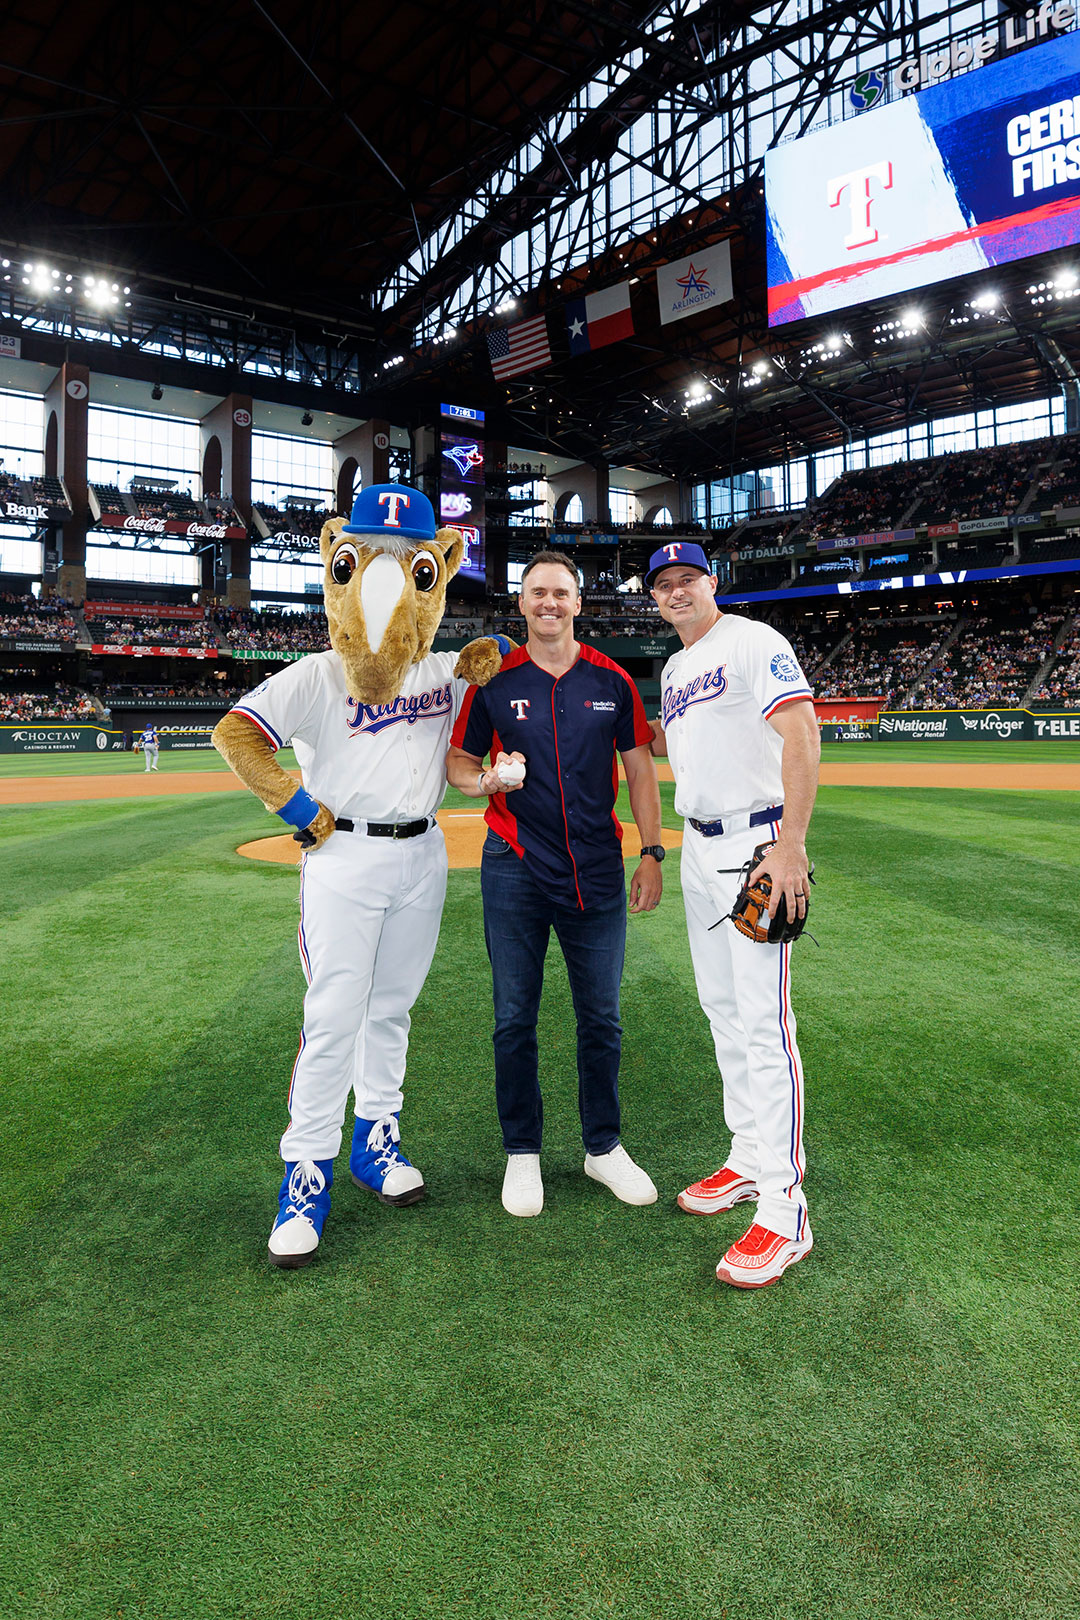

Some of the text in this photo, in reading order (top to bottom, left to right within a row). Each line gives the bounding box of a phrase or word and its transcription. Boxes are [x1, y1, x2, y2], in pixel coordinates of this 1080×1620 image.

[894, 2, 1076, 90] Globe Life
[827, 160, 893, 250] T
[672, 289, 716, 311] ARLINGTON
[0, 336, 15, 346] 23
[73, 384, 82, 395] 7
[235, 412, 249, 424] 29
[455, 407, 472, 418] 7:01
[377, 436, 386, 446] 10
[6, 502, 49, 519] Bank
[378, 492, 410, 528] T
[1017, 515, 1039, 524] PGL
[936, 526, 956, 535] PGL
[961, 520, 1005, 532] GoPGL.com
[834, 533, 895, 548] 105.3 THE FAN
[663, 543, 683, 562] T
[739, 545, 795, 560] UT DALLAS
[103, 644, 124, 652] DEX
[131, 645, 152, 653] DEX
[187, 647, 207, 655] DEX
[243, 650, 311, 661] LUXOR STA
[510, 699, 530, 720] T
[817, 714, 877, 724] tate Far
[153, 726, 214, 736] LOCKHEE
[980, 713, 1024, 738] Kroger
[1034, 720, 1080, 736] 7-ELE
[20, 731, 81, 741] CHOCTAW
